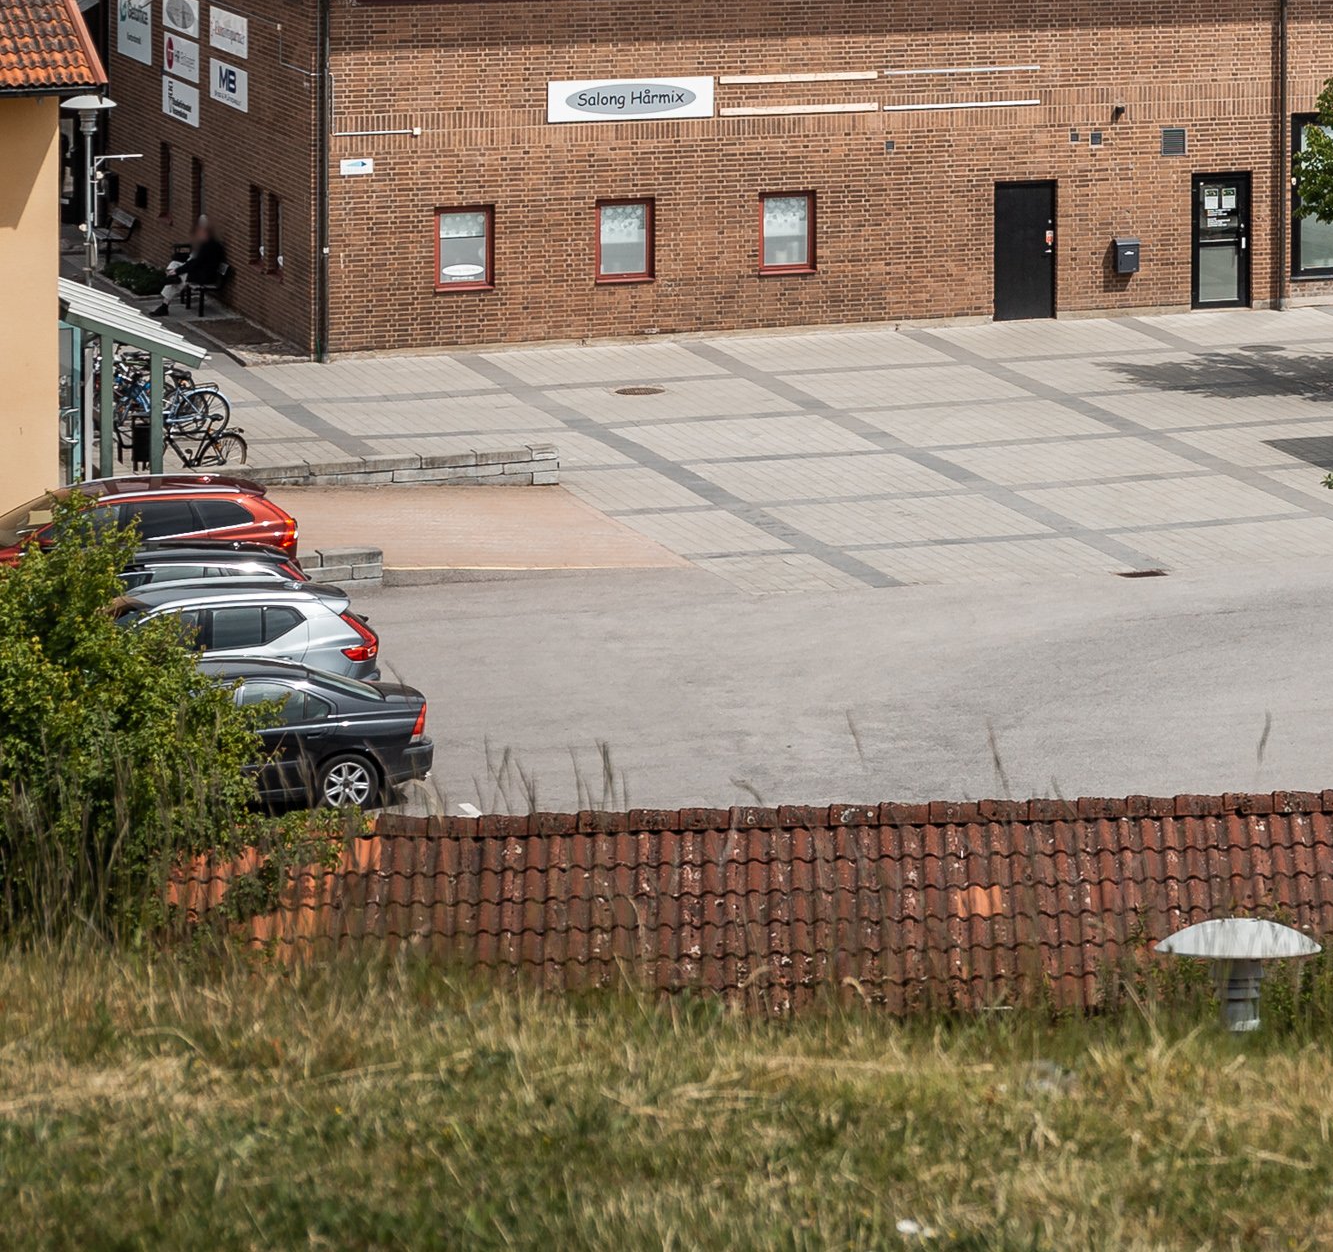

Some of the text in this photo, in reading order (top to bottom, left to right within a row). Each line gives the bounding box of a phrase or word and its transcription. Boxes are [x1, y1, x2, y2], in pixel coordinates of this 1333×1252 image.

[219, 65, 237, 94] MB
[577, 88, 685, 109] Salong Hårmix
